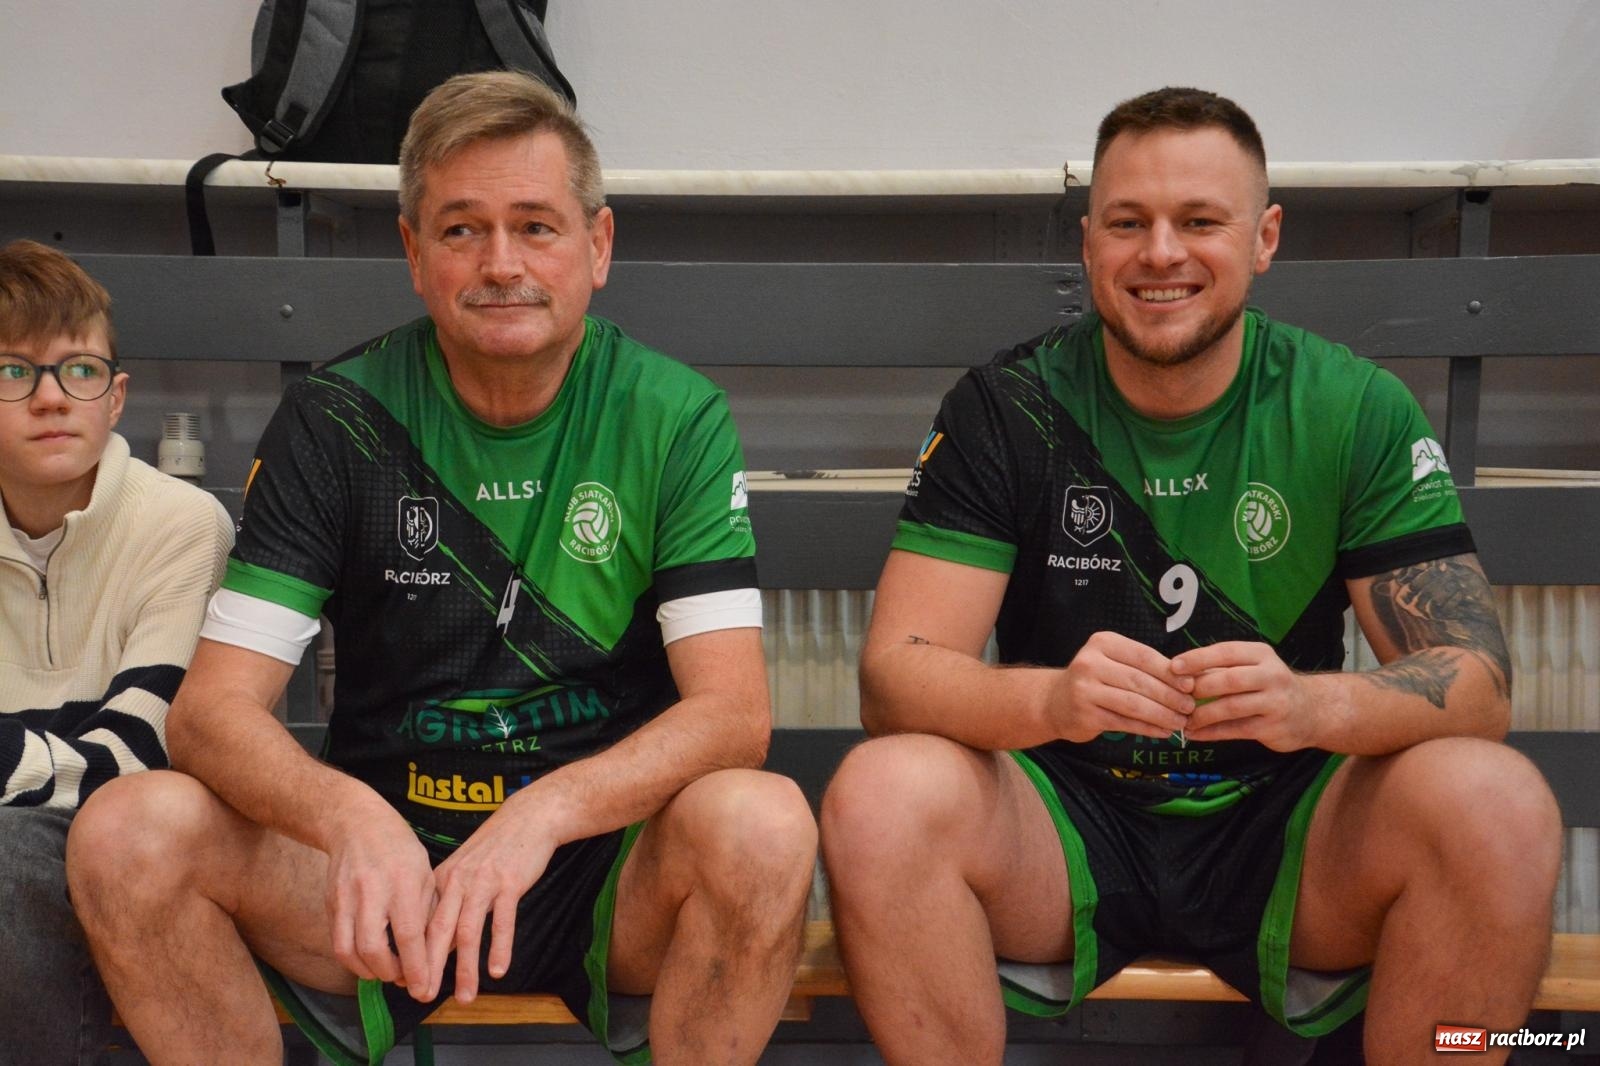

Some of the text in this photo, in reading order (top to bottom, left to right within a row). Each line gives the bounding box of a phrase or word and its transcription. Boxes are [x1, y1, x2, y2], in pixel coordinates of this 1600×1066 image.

[1144, 472, 1208, 496] ALLSX
[1048, 553, 1121, 572] RACIBÓRZ
[1158, 563, 1199, 633] 9
[1132, 749, 1216, 765] KIETRZ
